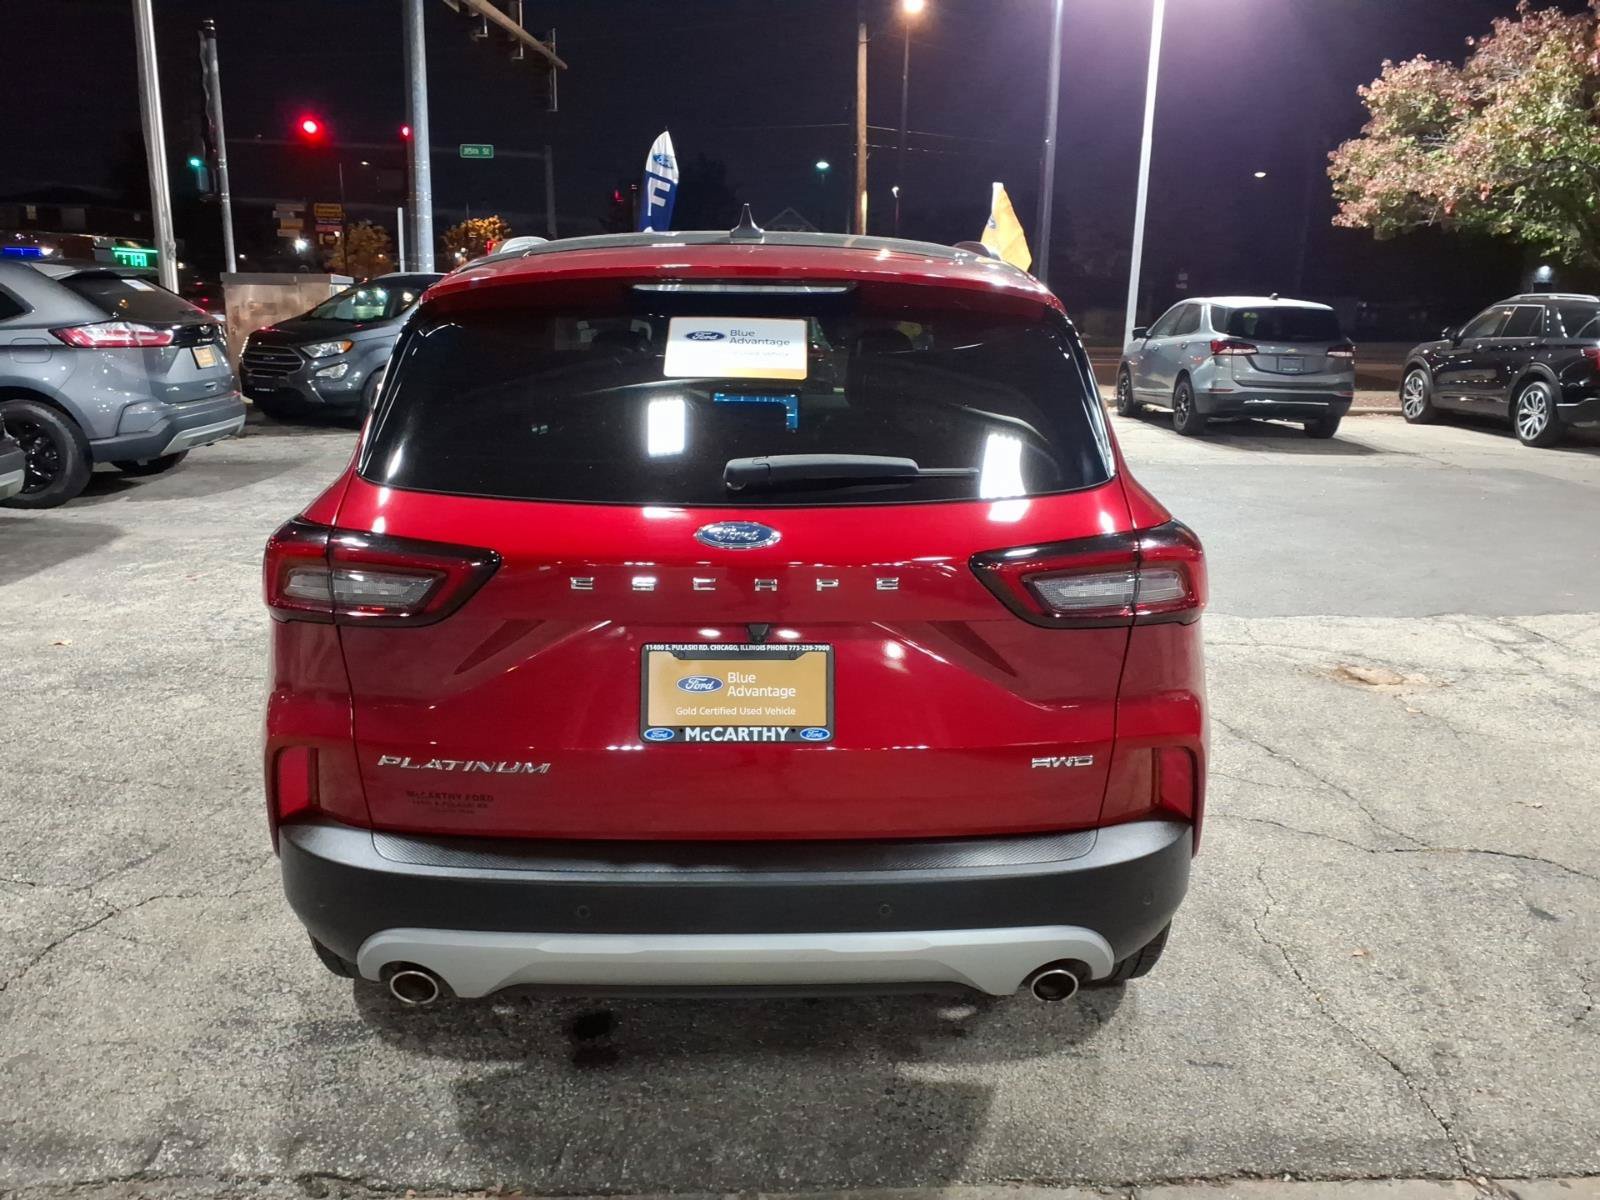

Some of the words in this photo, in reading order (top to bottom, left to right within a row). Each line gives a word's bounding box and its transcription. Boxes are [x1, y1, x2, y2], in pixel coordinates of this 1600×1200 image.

[730, 329, 756, 337] Blue
[729, 337, 791, 347] Advantage
[570, 576, 900, 591] ESCAPE
[710, 644, 740, 652] CHICAGO,
[727, 672, 756, 684] Blue
[727, 685, 797, 699] Advantage
[676, 707, 697, 716] Gold
[699, 706, 737, 716] Certified
[739, 707, 762, 716] Used
[765, 706, 796, 716] Vehicle
[685, 727, 790, 742] McCARTHY
[377, 754, 552, 774] PLATINUM
[1031, 755, 1093, 768] AWD
